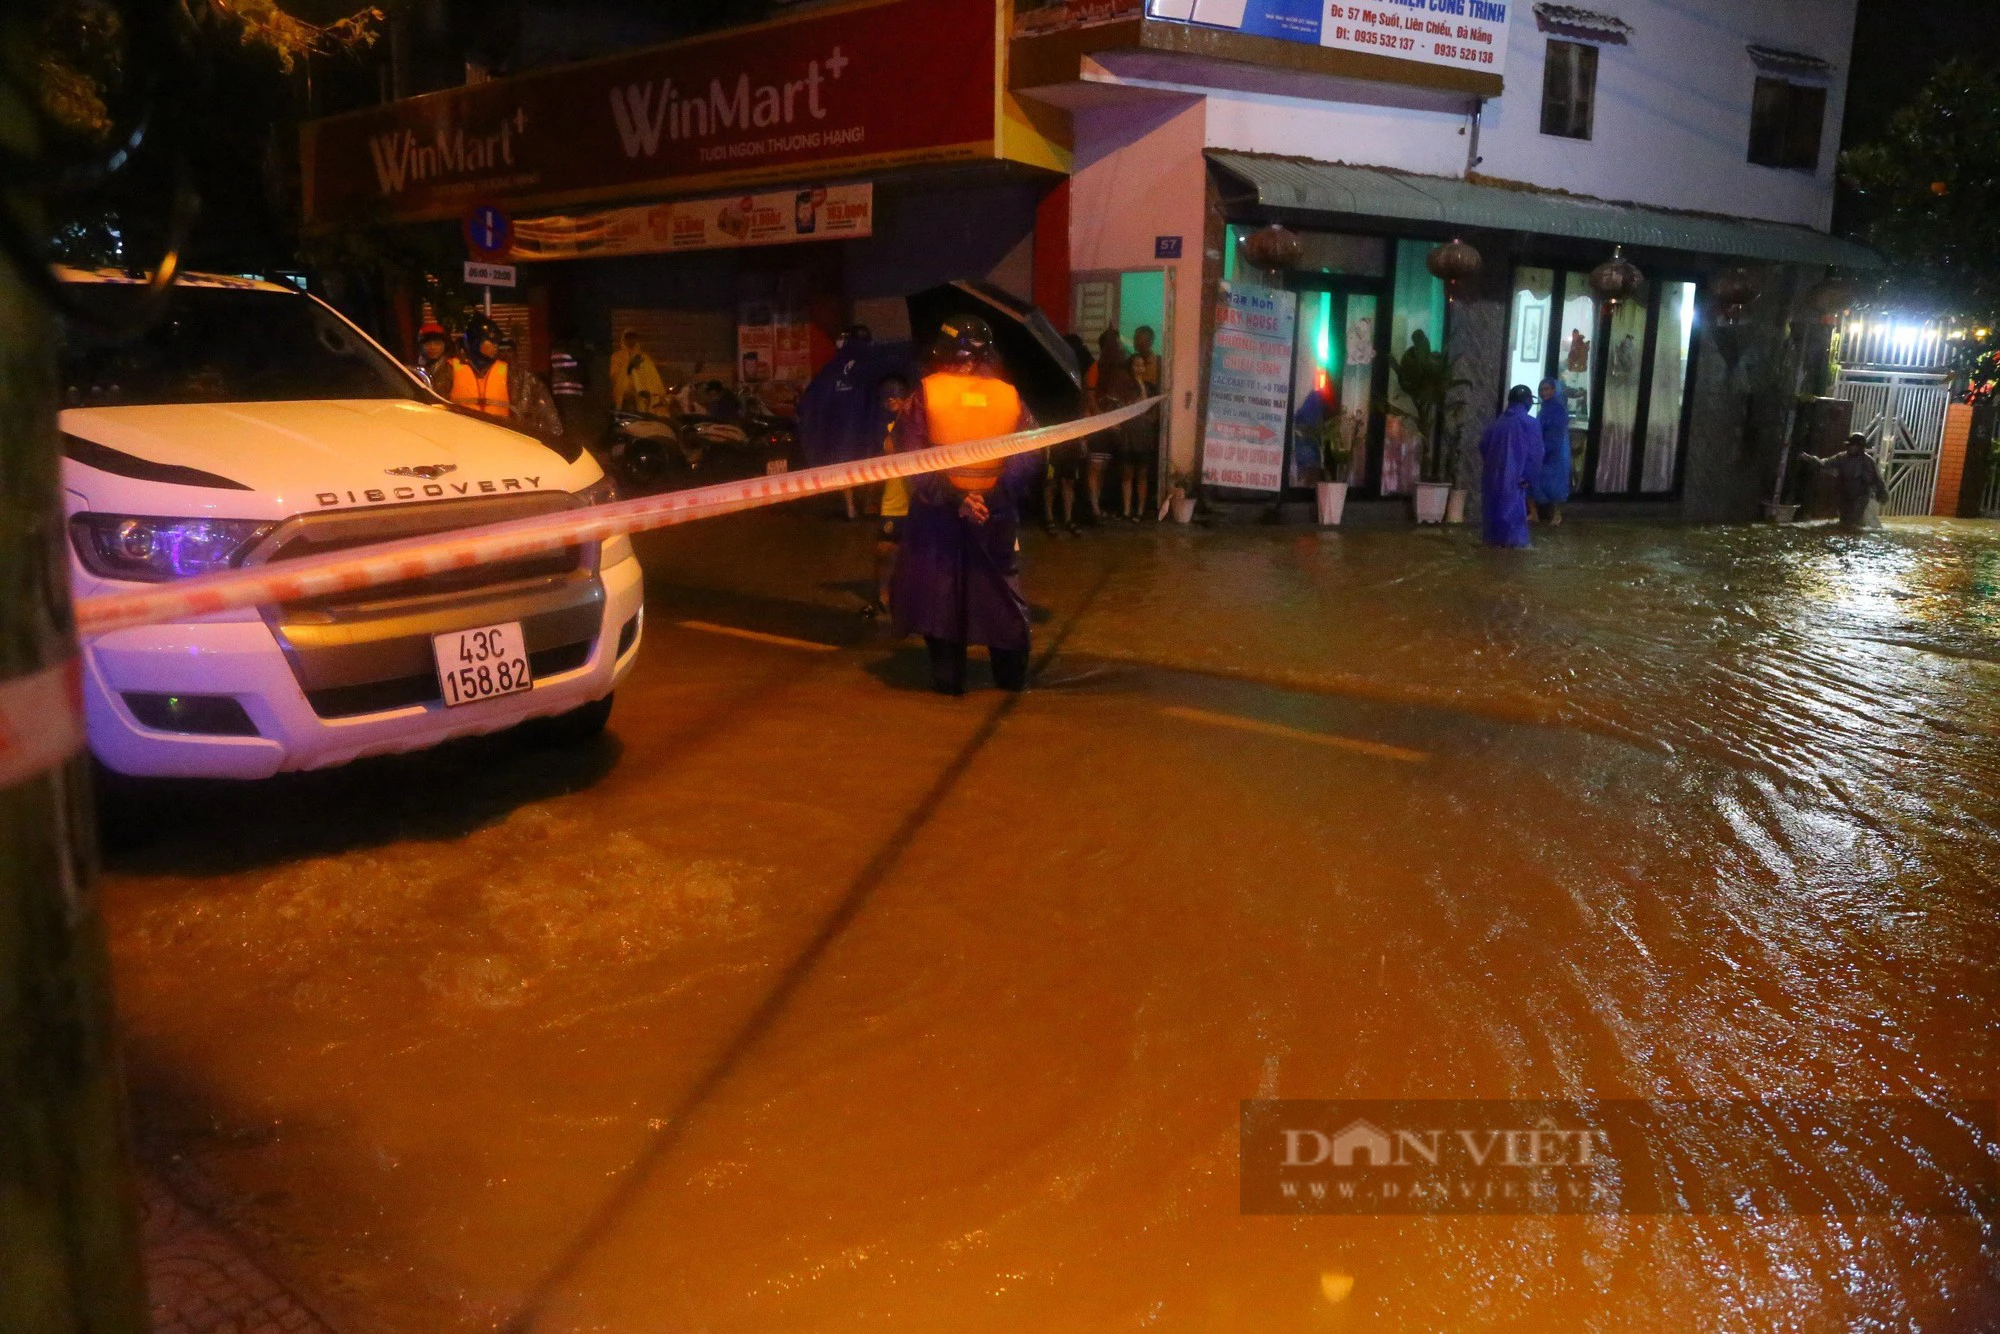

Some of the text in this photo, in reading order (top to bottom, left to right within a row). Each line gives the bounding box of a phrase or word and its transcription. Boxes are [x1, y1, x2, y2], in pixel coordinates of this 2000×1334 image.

[1347, 7, 1360, 21] 57
[1405, 17, 1423, 31] Liên
[1456, 26, 1468, 39] Đà
[1354, 29, 1377, 44] 0935
[1379, 34, 1396, 48] 532
[1399, 37, 1415, 51] 137
[1434, 43, 1457, 58] 0935
[1459, 47, 1476, 61] 526
[1478, 50, 1493, 63] 138
[1160, 239, 1178, 250] 57
[316, 476, 541, 506] DISCOVERY
[460, 629, 505, 664] 43C
[447, 658, 529, 702] 158.82
